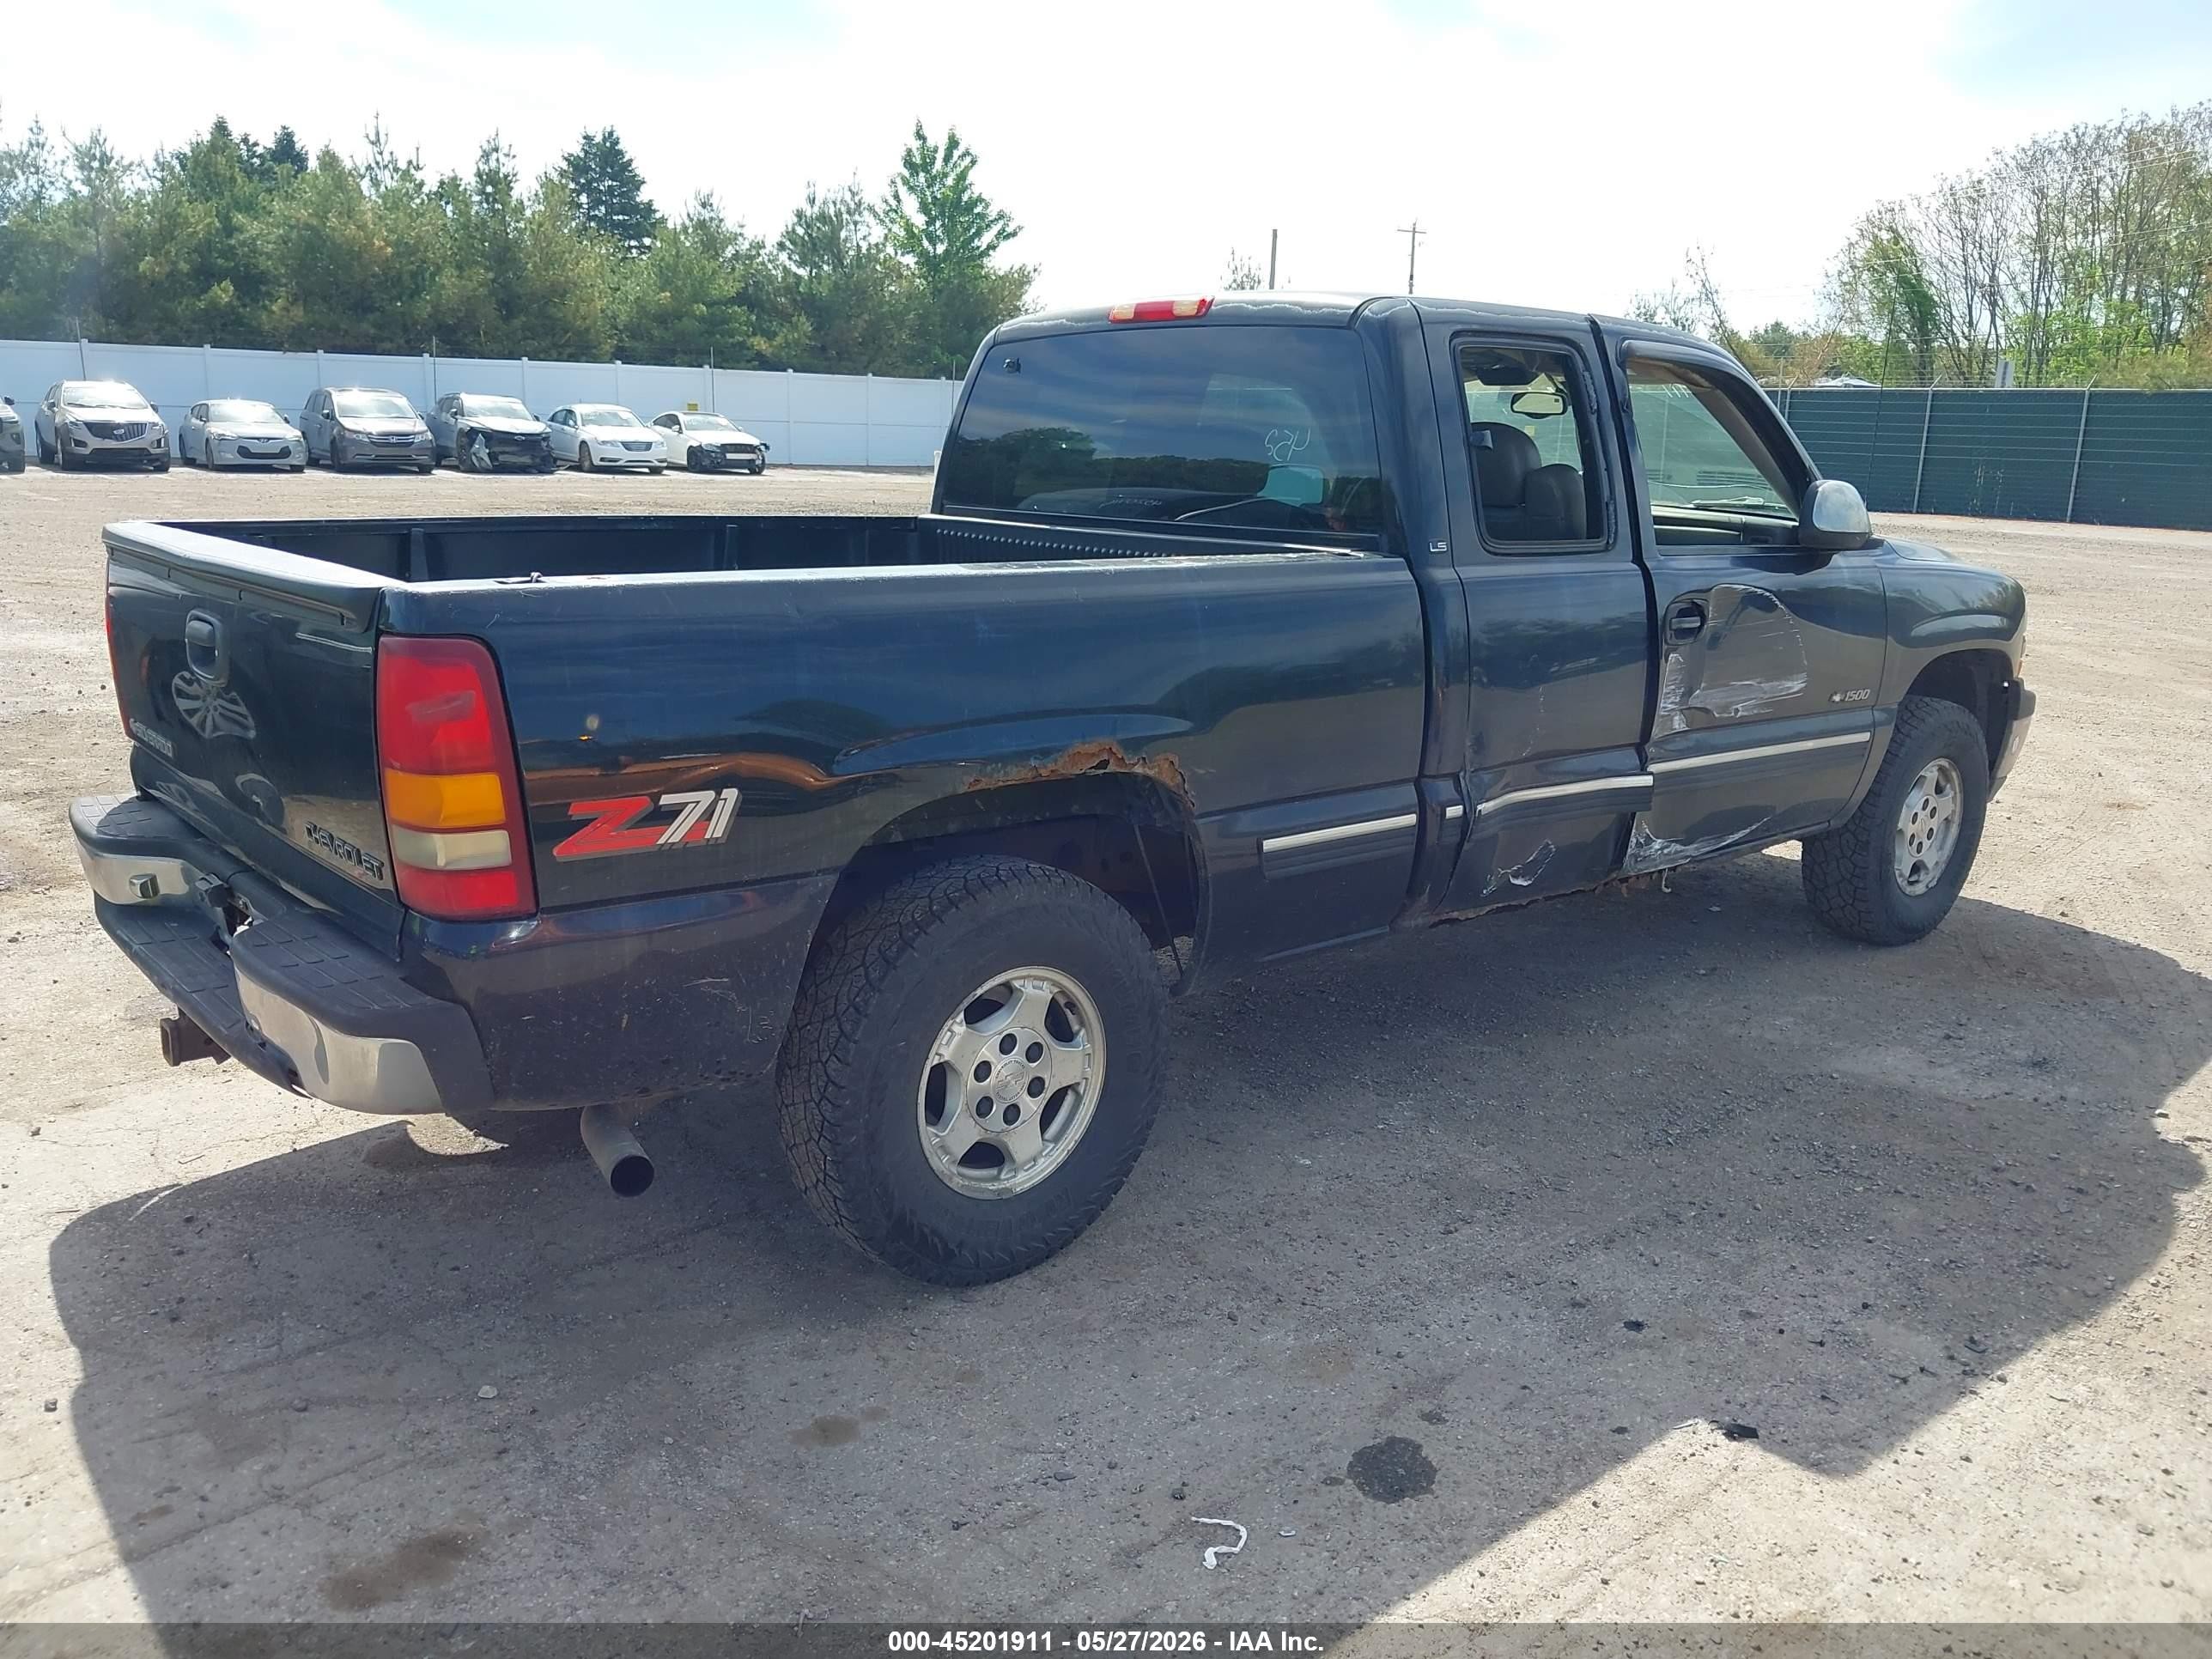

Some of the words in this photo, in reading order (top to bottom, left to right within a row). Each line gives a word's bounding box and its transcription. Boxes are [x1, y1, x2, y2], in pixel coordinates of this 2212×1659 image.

[1429, 542, 1448, 552] LS
[1844, 689, 1871, 702] 1500
[553, 787, 742, 862] Z71
[304, 821, 384, 881] CHEVROLET
